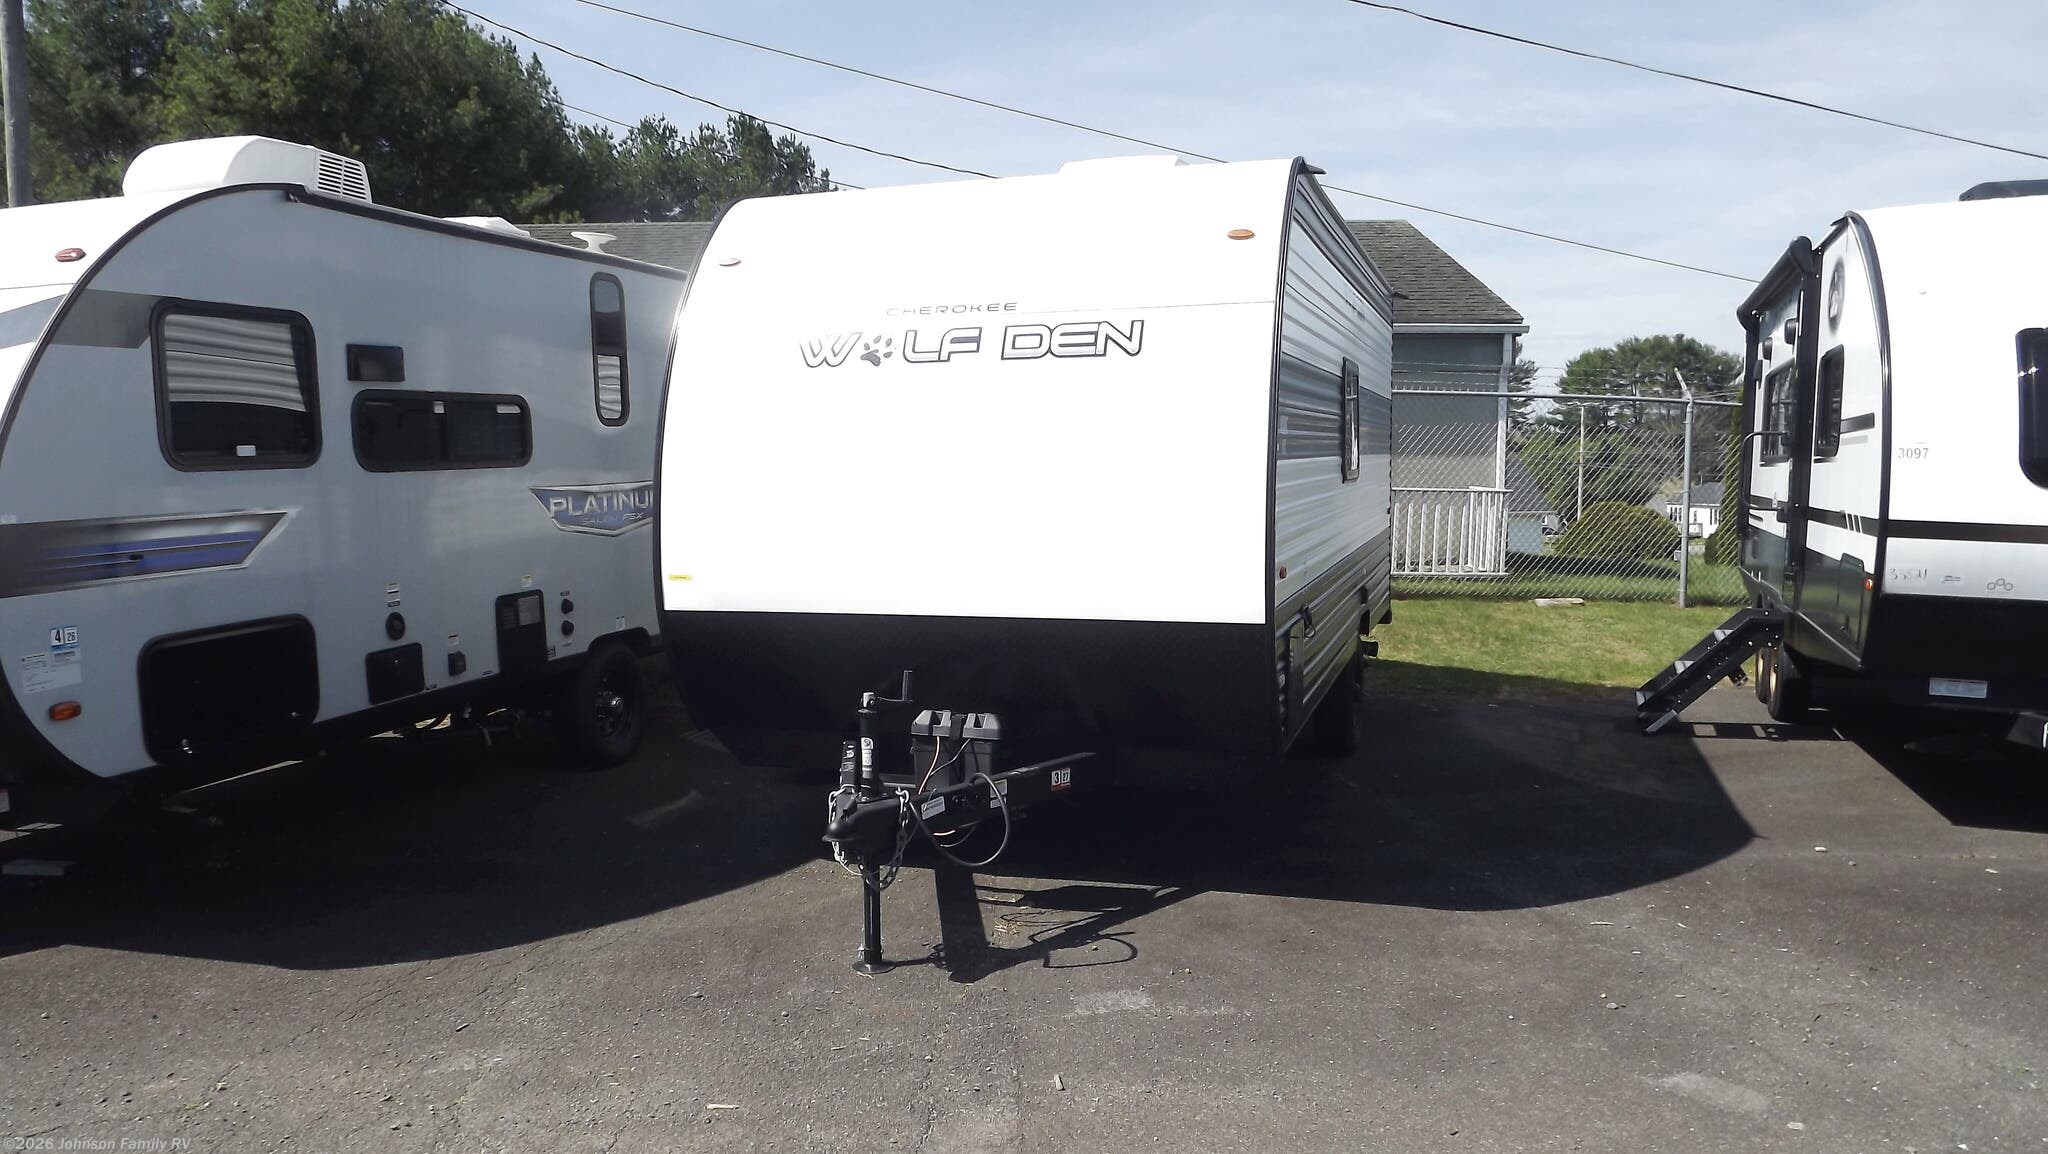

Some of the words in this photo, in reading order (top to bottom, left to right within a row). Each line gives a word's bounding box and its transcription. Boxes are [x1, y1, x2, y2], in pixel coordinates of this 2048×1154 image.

[887, 302, 1018, 316] CHEROKEE
[1001, 319, 1144, 360] DEN
[1897, 447, 1929, 460] 3097
